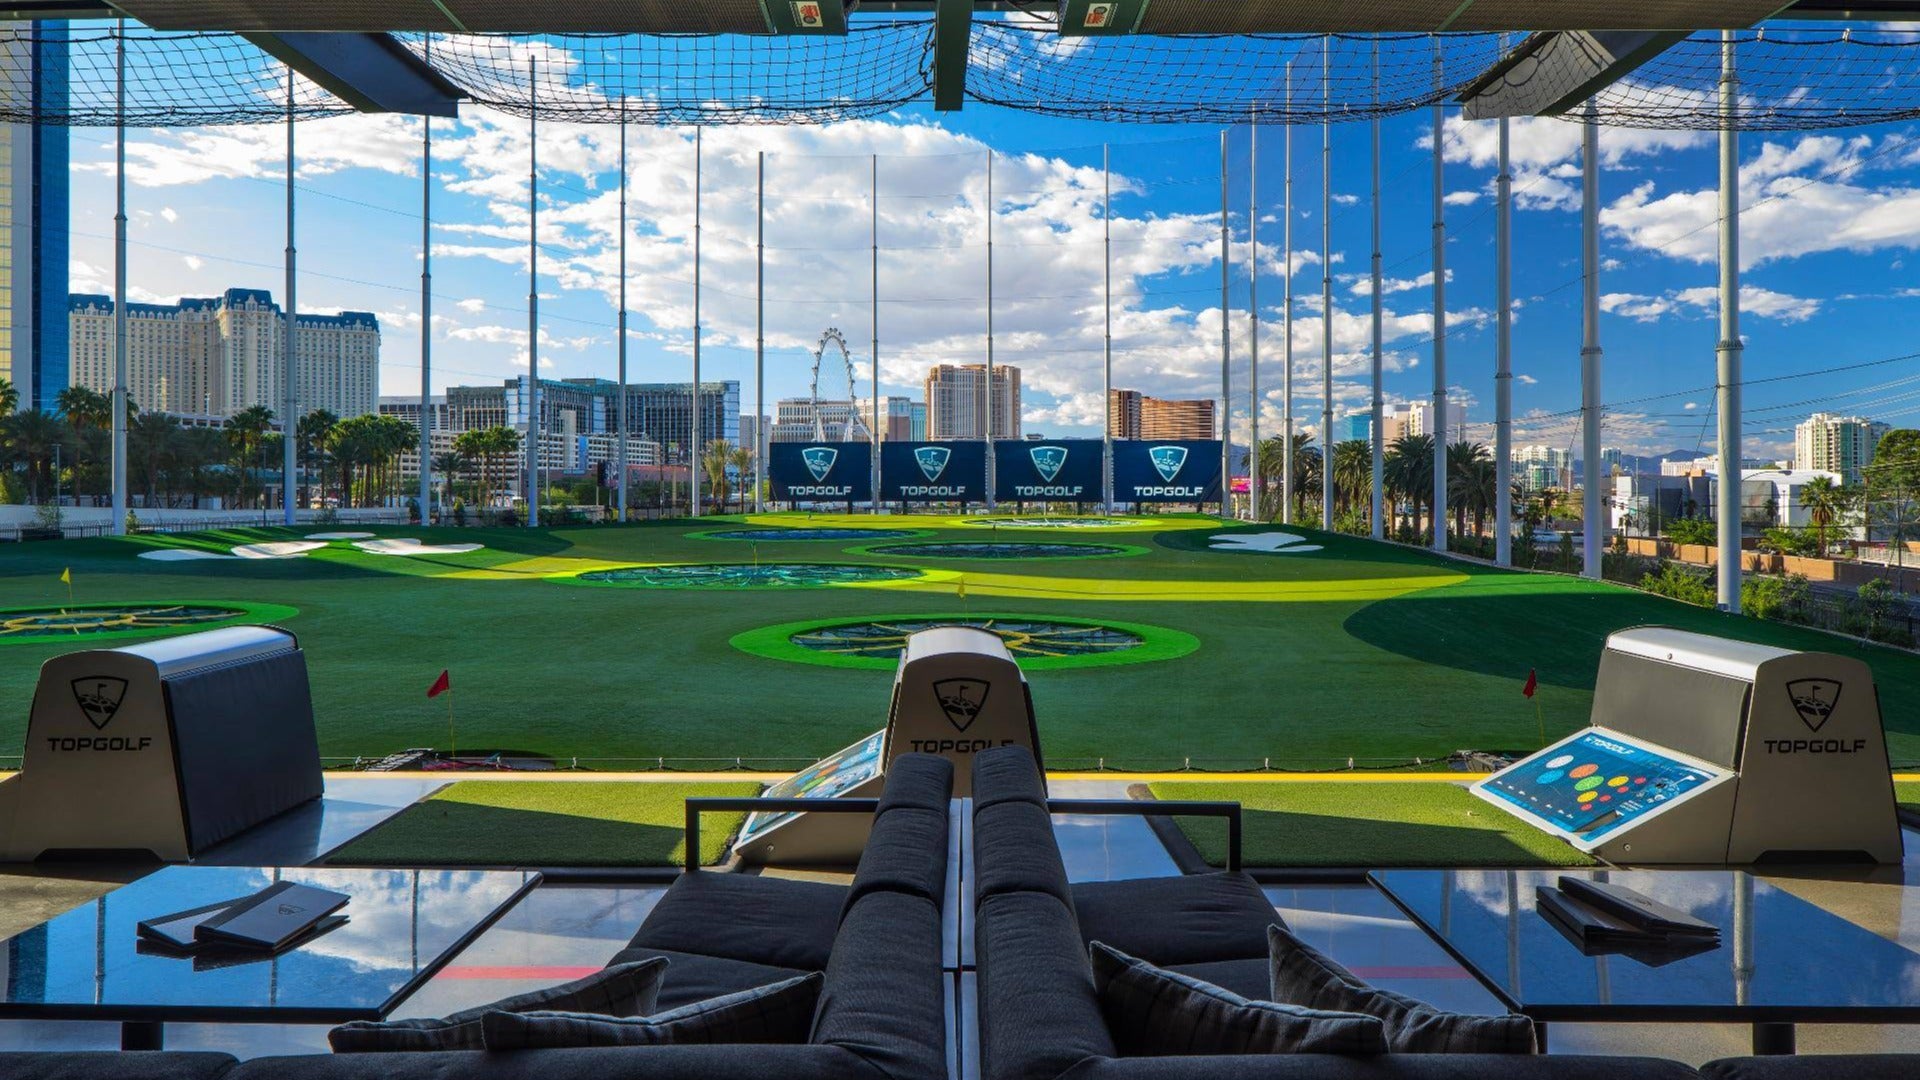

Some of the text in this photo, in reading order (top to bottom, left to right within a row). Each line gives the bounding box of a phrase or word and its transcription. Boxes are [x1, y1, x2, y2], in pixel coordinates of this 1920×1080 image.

[788, 486, 852, 495] TOPGOLF
[900, 486, 966, 495] TOPGOLF
[1015, 486, 1083, 496] TOPGOLF
[1134, 486, 1204, 496] TOPGOLF
[47, 737, 152, 751] TOPGOLF
[1764, 740, 1866, 753] TOPGOLF
